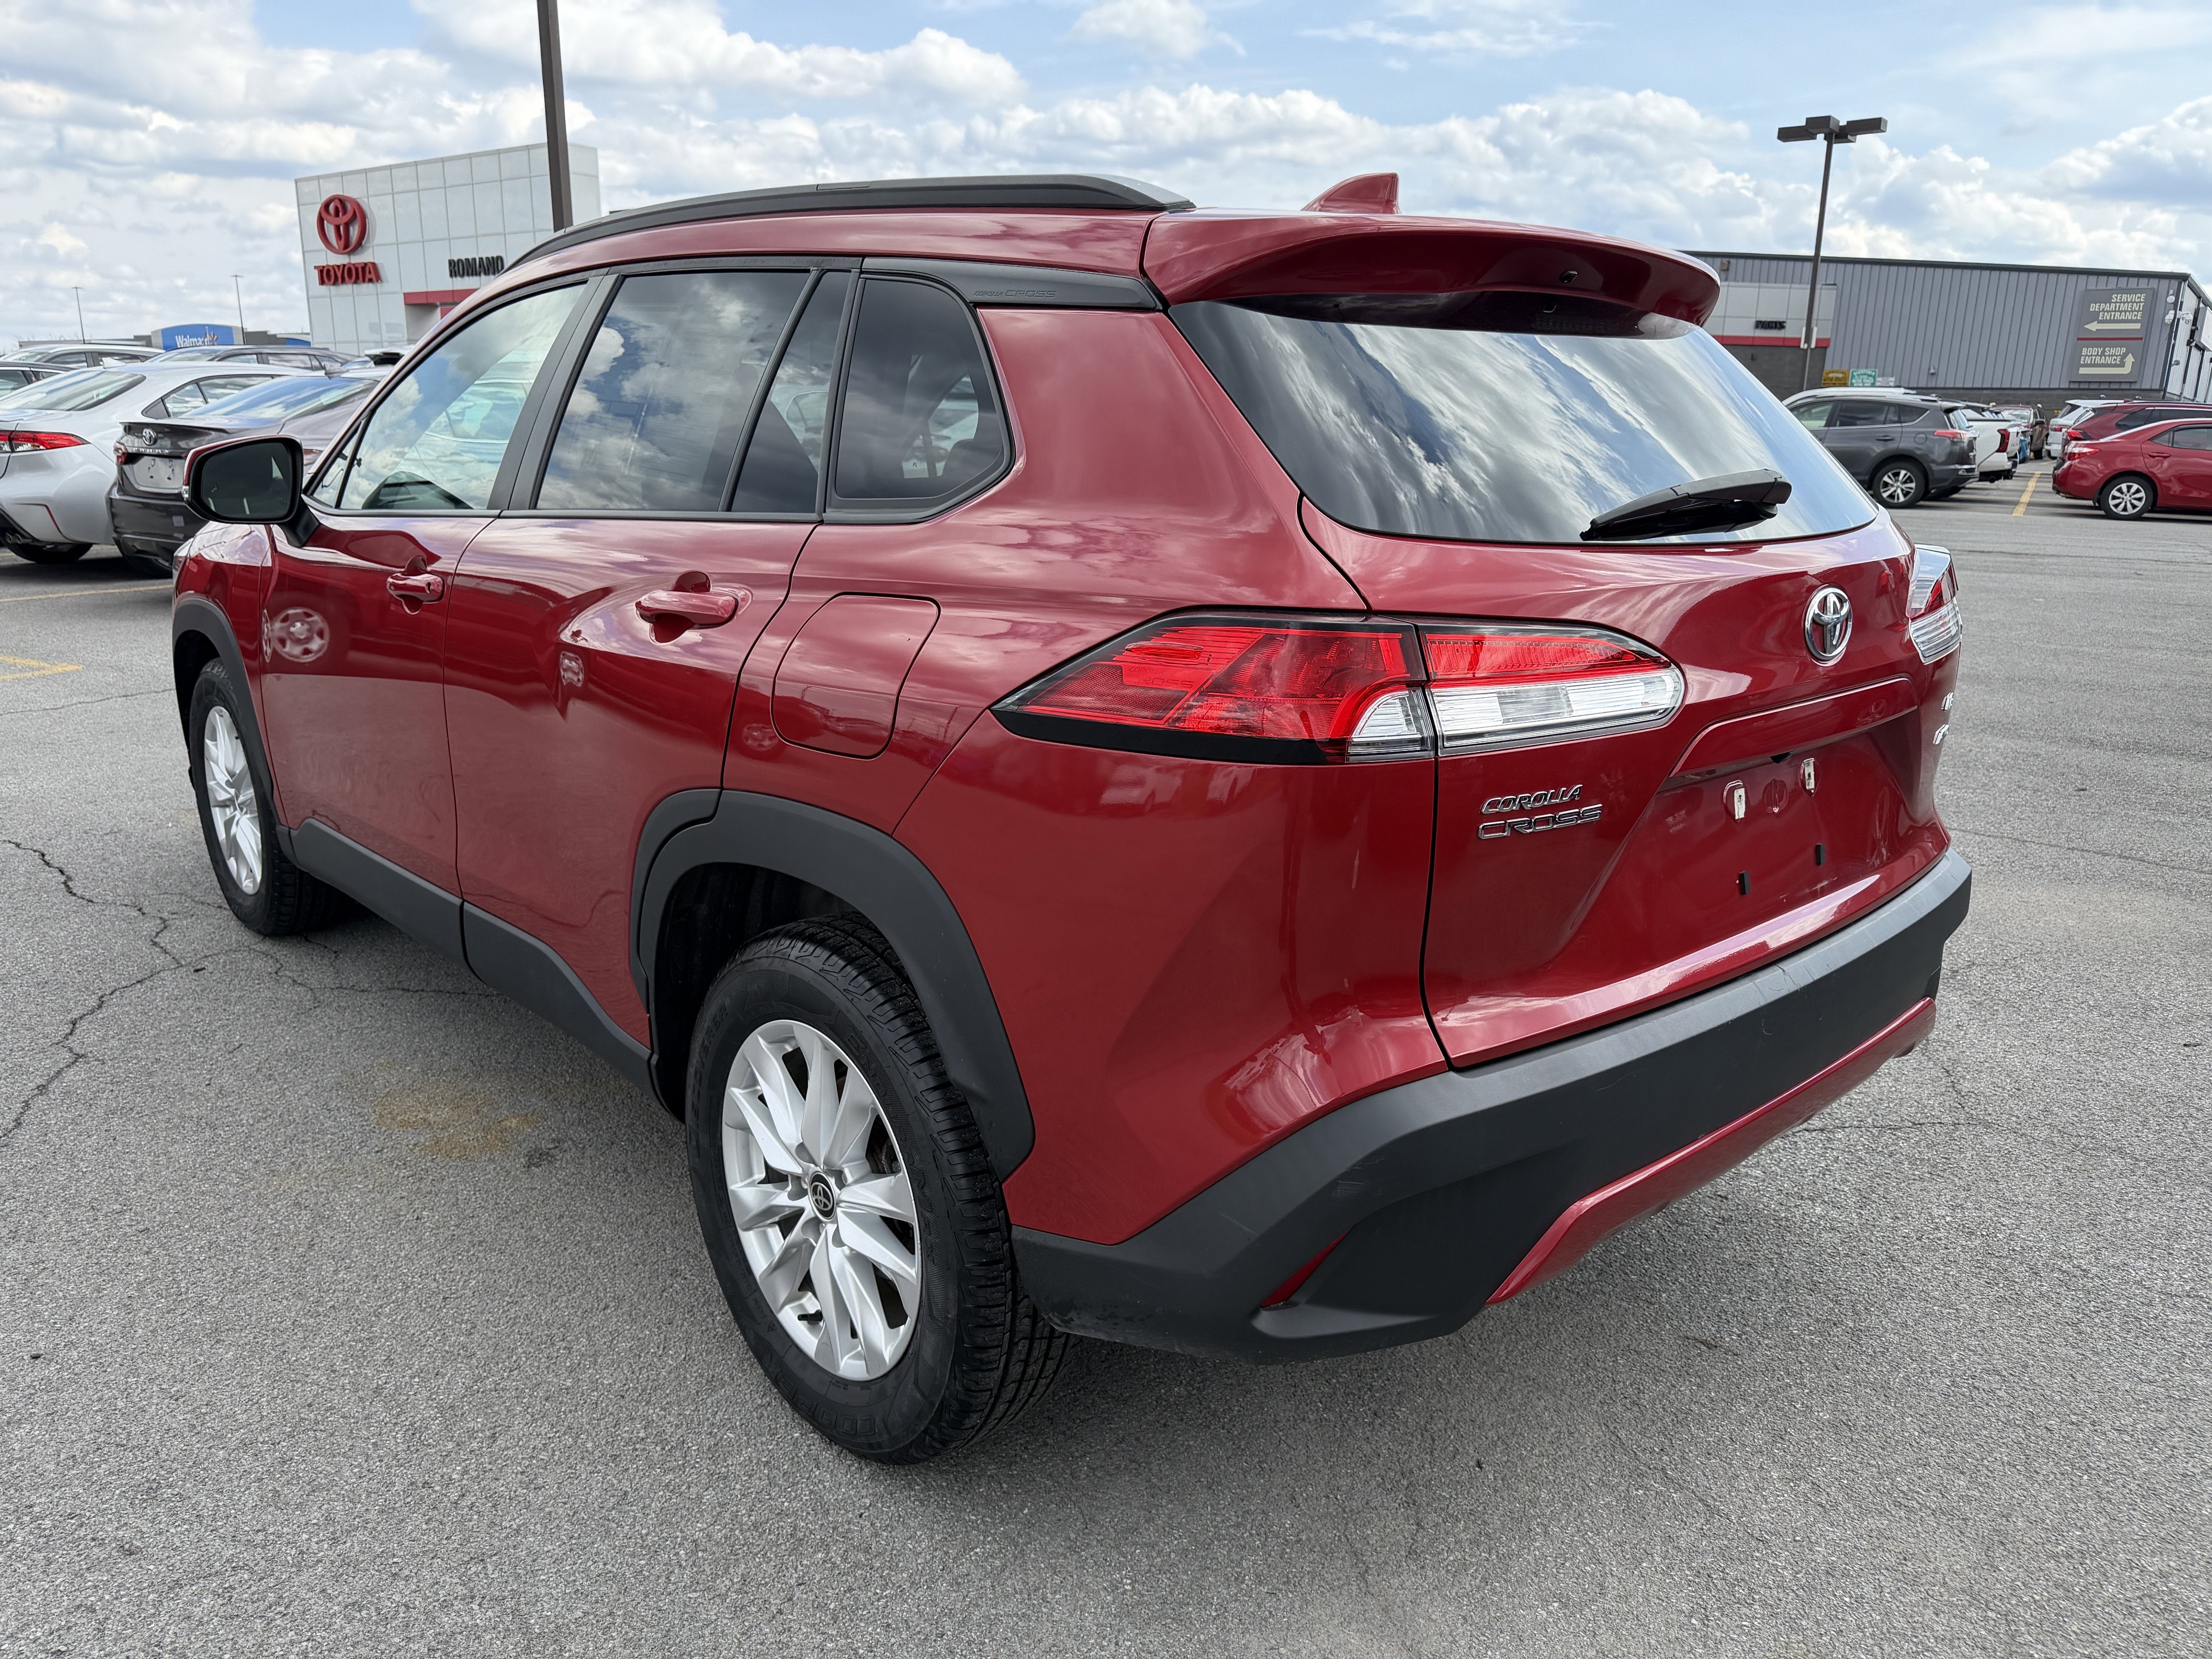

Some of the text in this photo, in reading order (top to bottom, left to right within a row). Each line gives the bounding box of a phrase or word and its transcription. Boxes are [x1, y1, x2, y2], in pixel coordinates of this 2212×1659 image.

[448, 256, 504, 278] ROMANO
[314, 262, 381, 286] TOYOTA
[1005, 290, 1057, 298] CROSS
[2112, 294, 2146, 302] SERVICE
[2090, 303, 2144, 311] DEPARTMENT
[2099, 312, 2143, 320] ENTRANCE
[2082, 347, 2126, 356] BODY SHOP
[2080, 356, 2121, 364] ENTRANCE
[1480, 784, 1583, 814] COROLLA
[1478, 804, 1603, 839] CROSS
